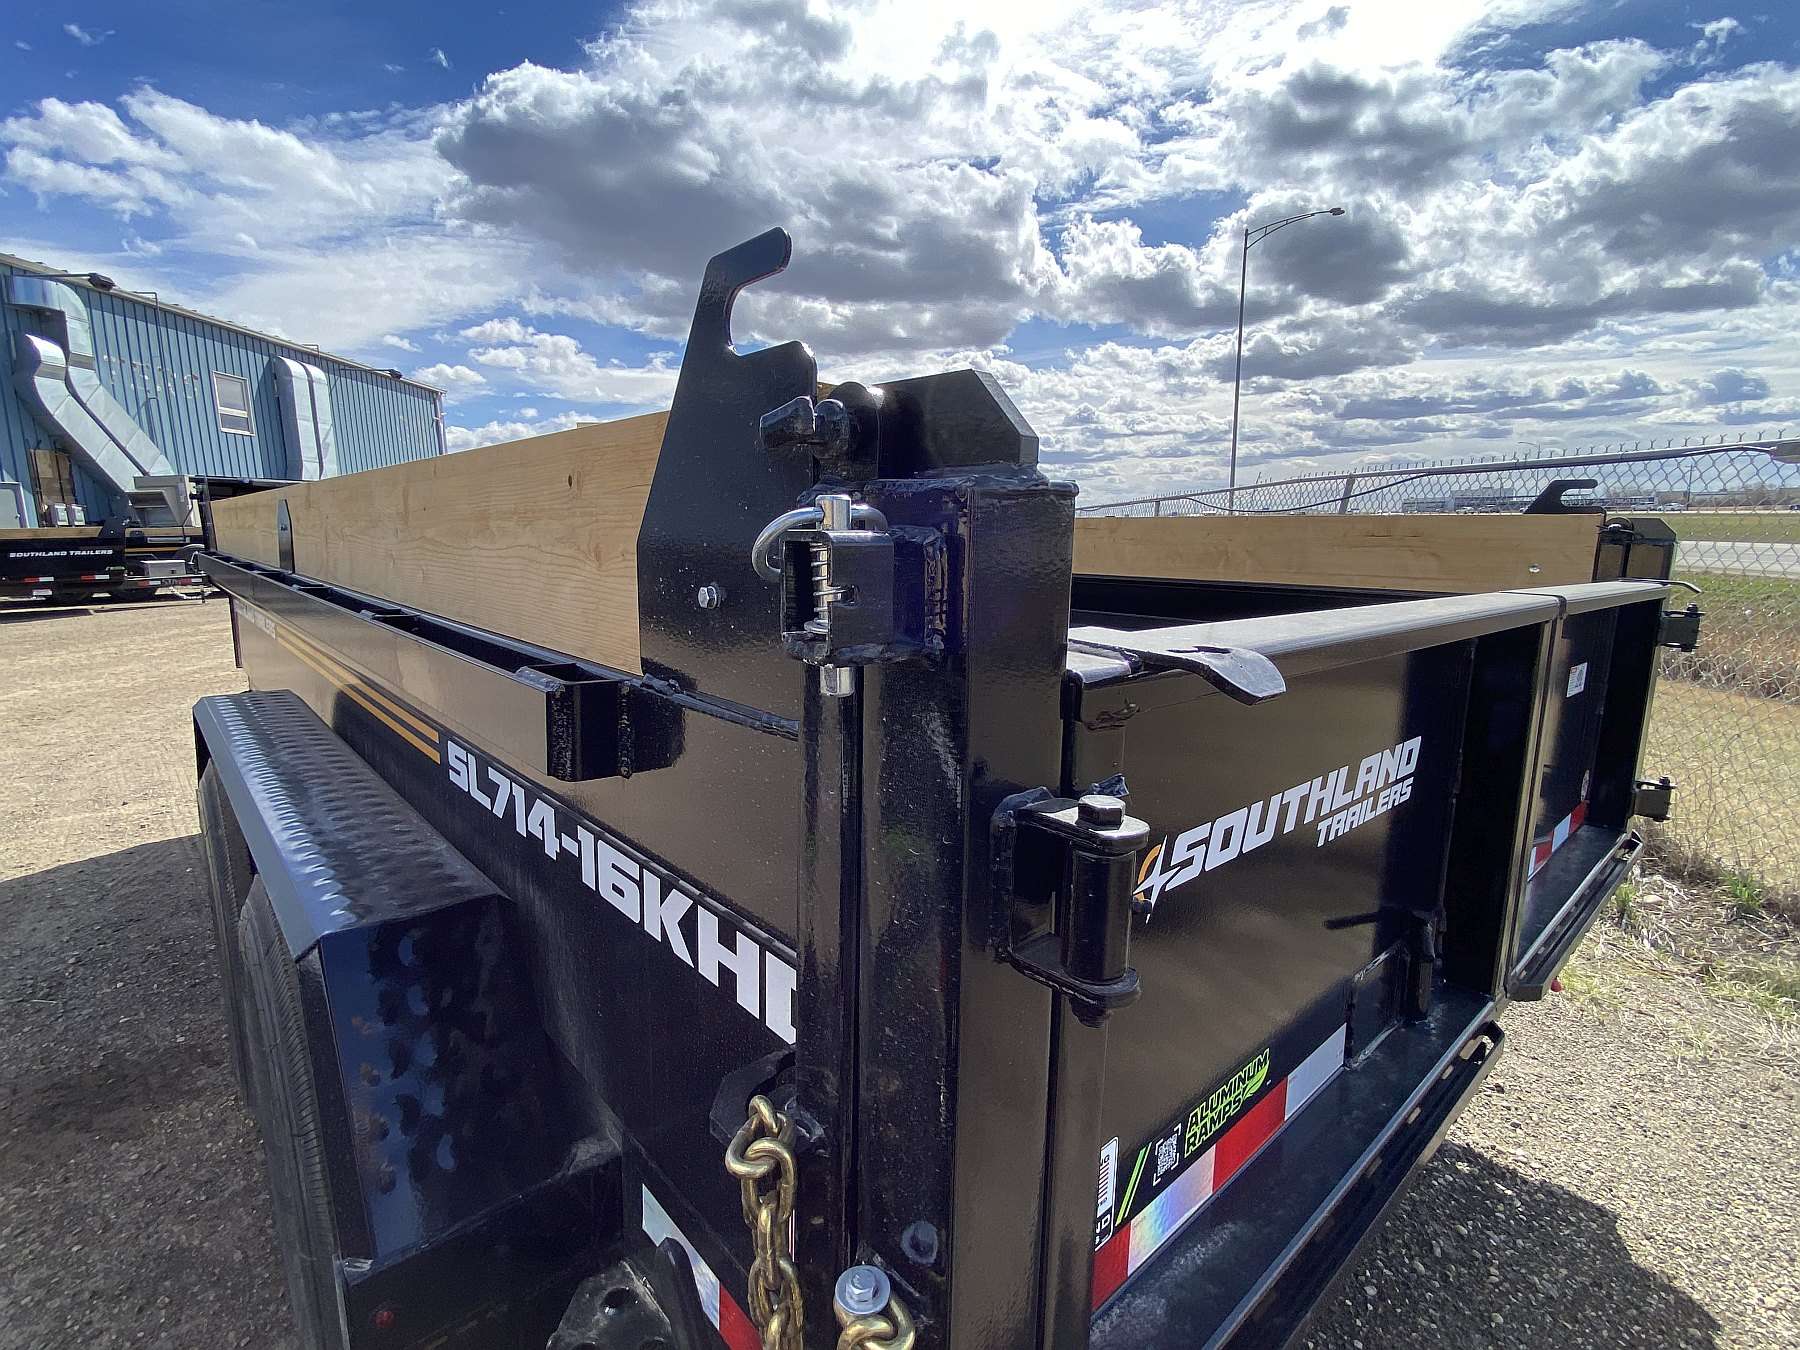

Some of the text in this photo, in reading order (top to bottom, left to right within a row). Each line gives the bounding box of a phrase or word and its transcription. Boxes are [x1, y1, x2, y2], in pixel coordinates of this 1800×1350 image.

[1165, 736, 1421, 891] SOUTHLAND
[1317, 777, 1414, 848] TRAILERS
[1184, 1090, 1244, 1158] RAMPS
[1187, 1047, 1270, 1135] ALUMINUM
